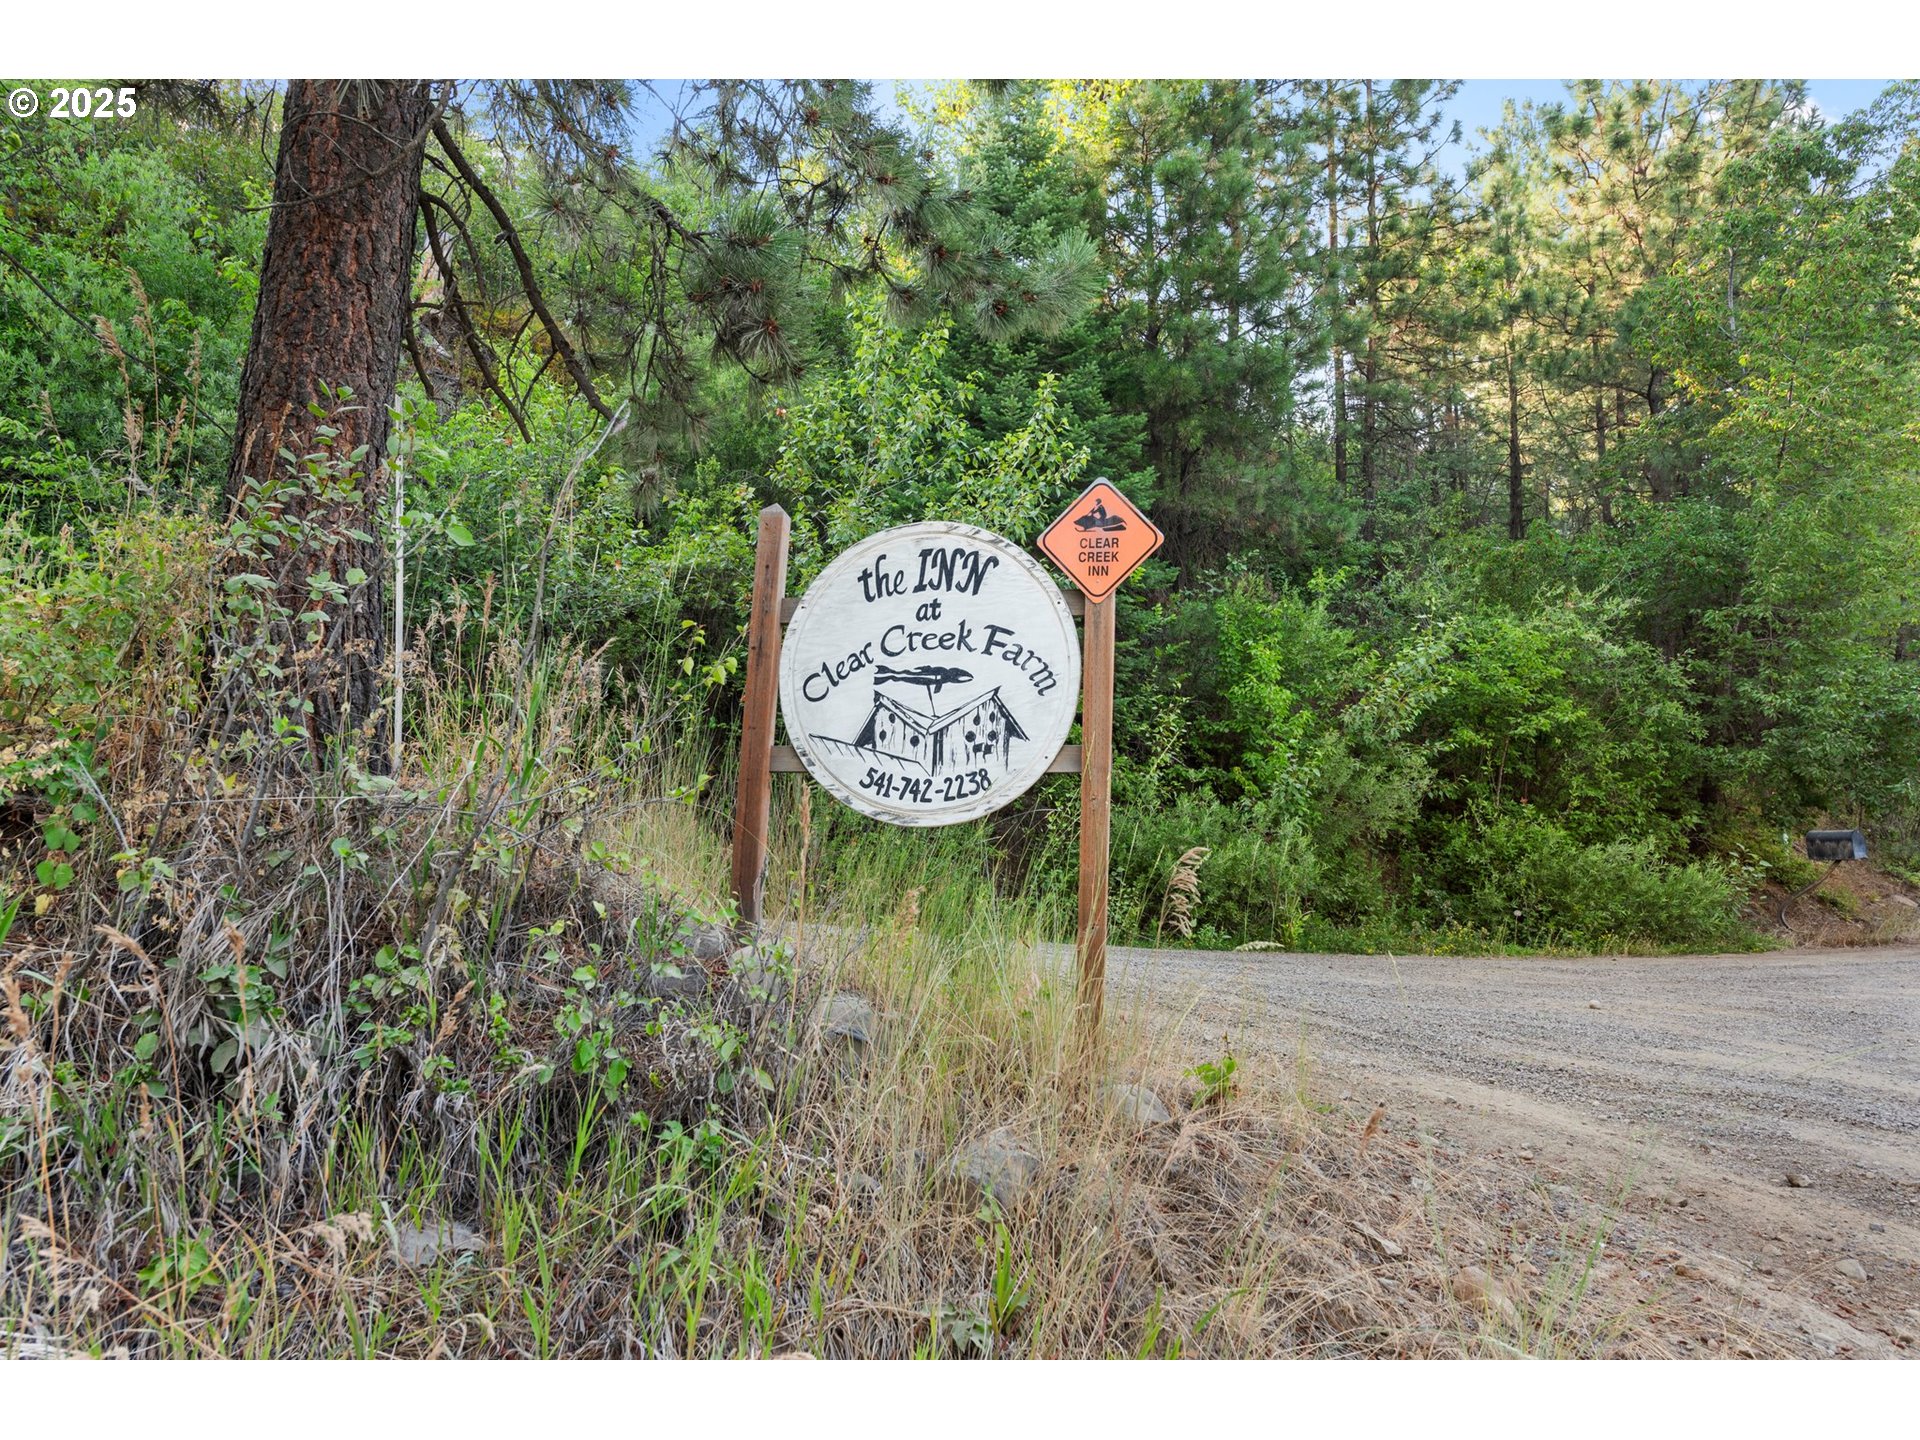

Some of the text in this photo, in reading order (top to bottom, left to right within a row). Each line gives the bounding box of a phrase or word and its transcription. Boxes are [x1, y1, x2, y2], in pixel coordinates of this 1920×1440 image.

[1079, 537, 1119, 549] CLEAR
[1078, 551, 1119, 563] CREEK
[857, 547, 1000, 602] the INN
[1088, 565, 1109, 577] INN
[915, 598, 941, 621] at
[802, 619, 1057, 702] Clear Creek Farm
[859, 767, 992, 803] 541-742-2238
